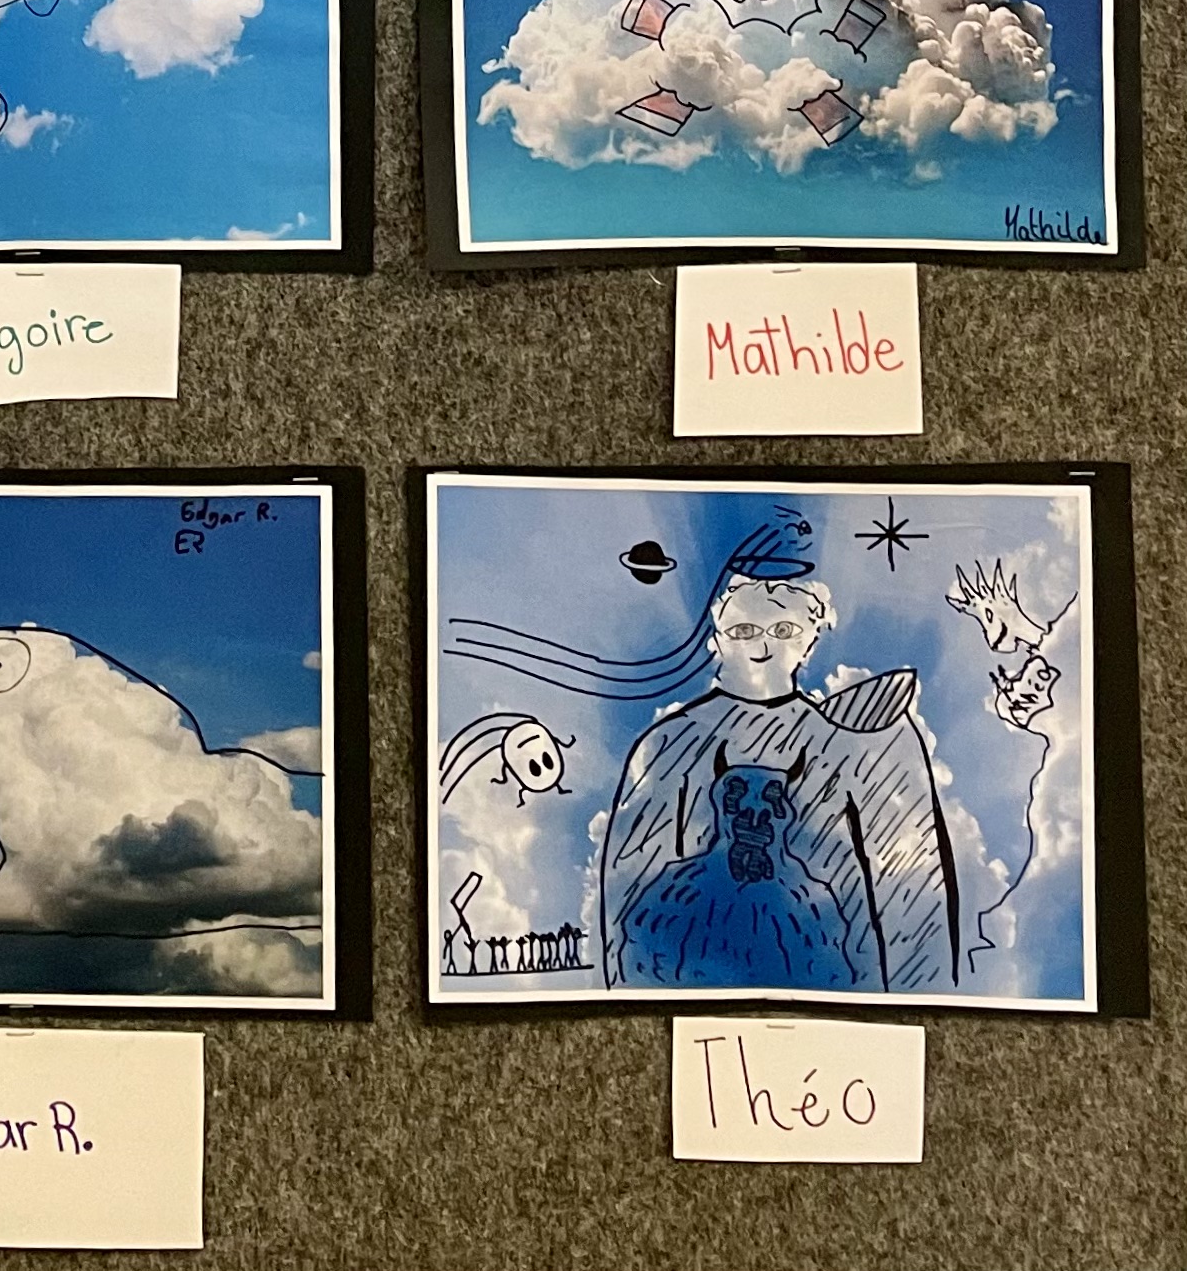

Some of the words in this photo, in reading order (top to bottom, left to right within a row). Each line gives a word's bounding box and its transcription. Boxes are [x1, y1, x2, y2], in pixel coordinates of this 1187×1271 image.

[1004, 203, 1110, 247] Mathilde
[706, 307, 905, 380] Mathilde
[256, 502, 278, 523] R.
[694, 1035, 876, 1131] Théo
[49, 1101, 93, 1155] R.
